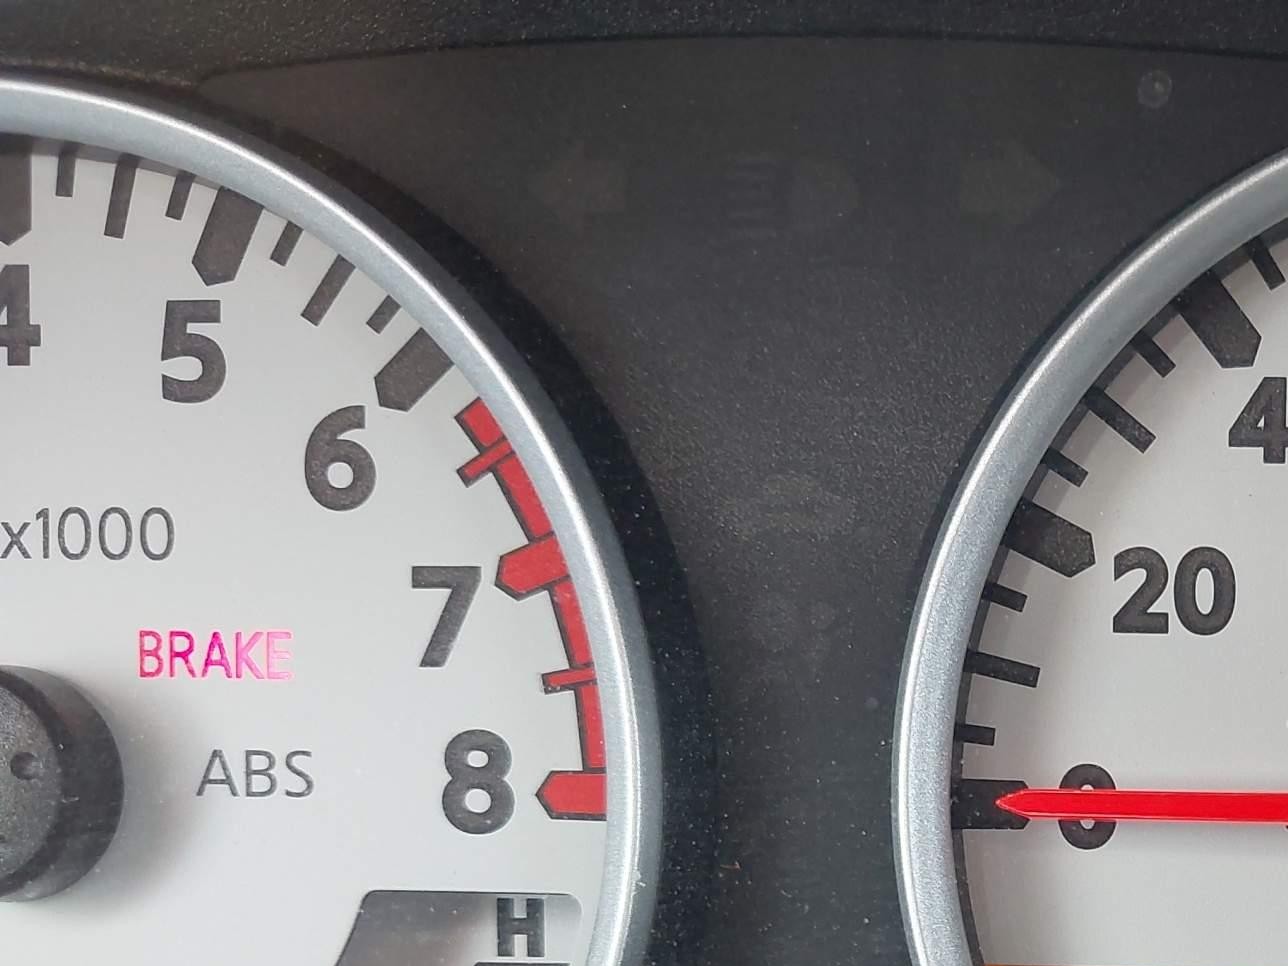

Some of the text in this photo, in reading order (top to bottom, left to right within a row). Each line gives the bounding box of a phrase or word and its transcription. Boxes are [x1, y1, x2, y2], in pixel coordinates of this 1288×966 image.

[0, 264, 41, 366] 4
[160, 300, 227, 404] 5
[304, 405, 377, 511] 6
[0, 507, 175, 561] x1000
[411, 565, 482, 668] 7
[1112, 546, 1236, 636] 20
[138, 630, 293, 680] BRAKE
[196, 748, 314, 799] ABS
[442, 729, 515, 835] 8
[1058, 763, 1118, 850] 0
[496, 897, 546, 958] H
